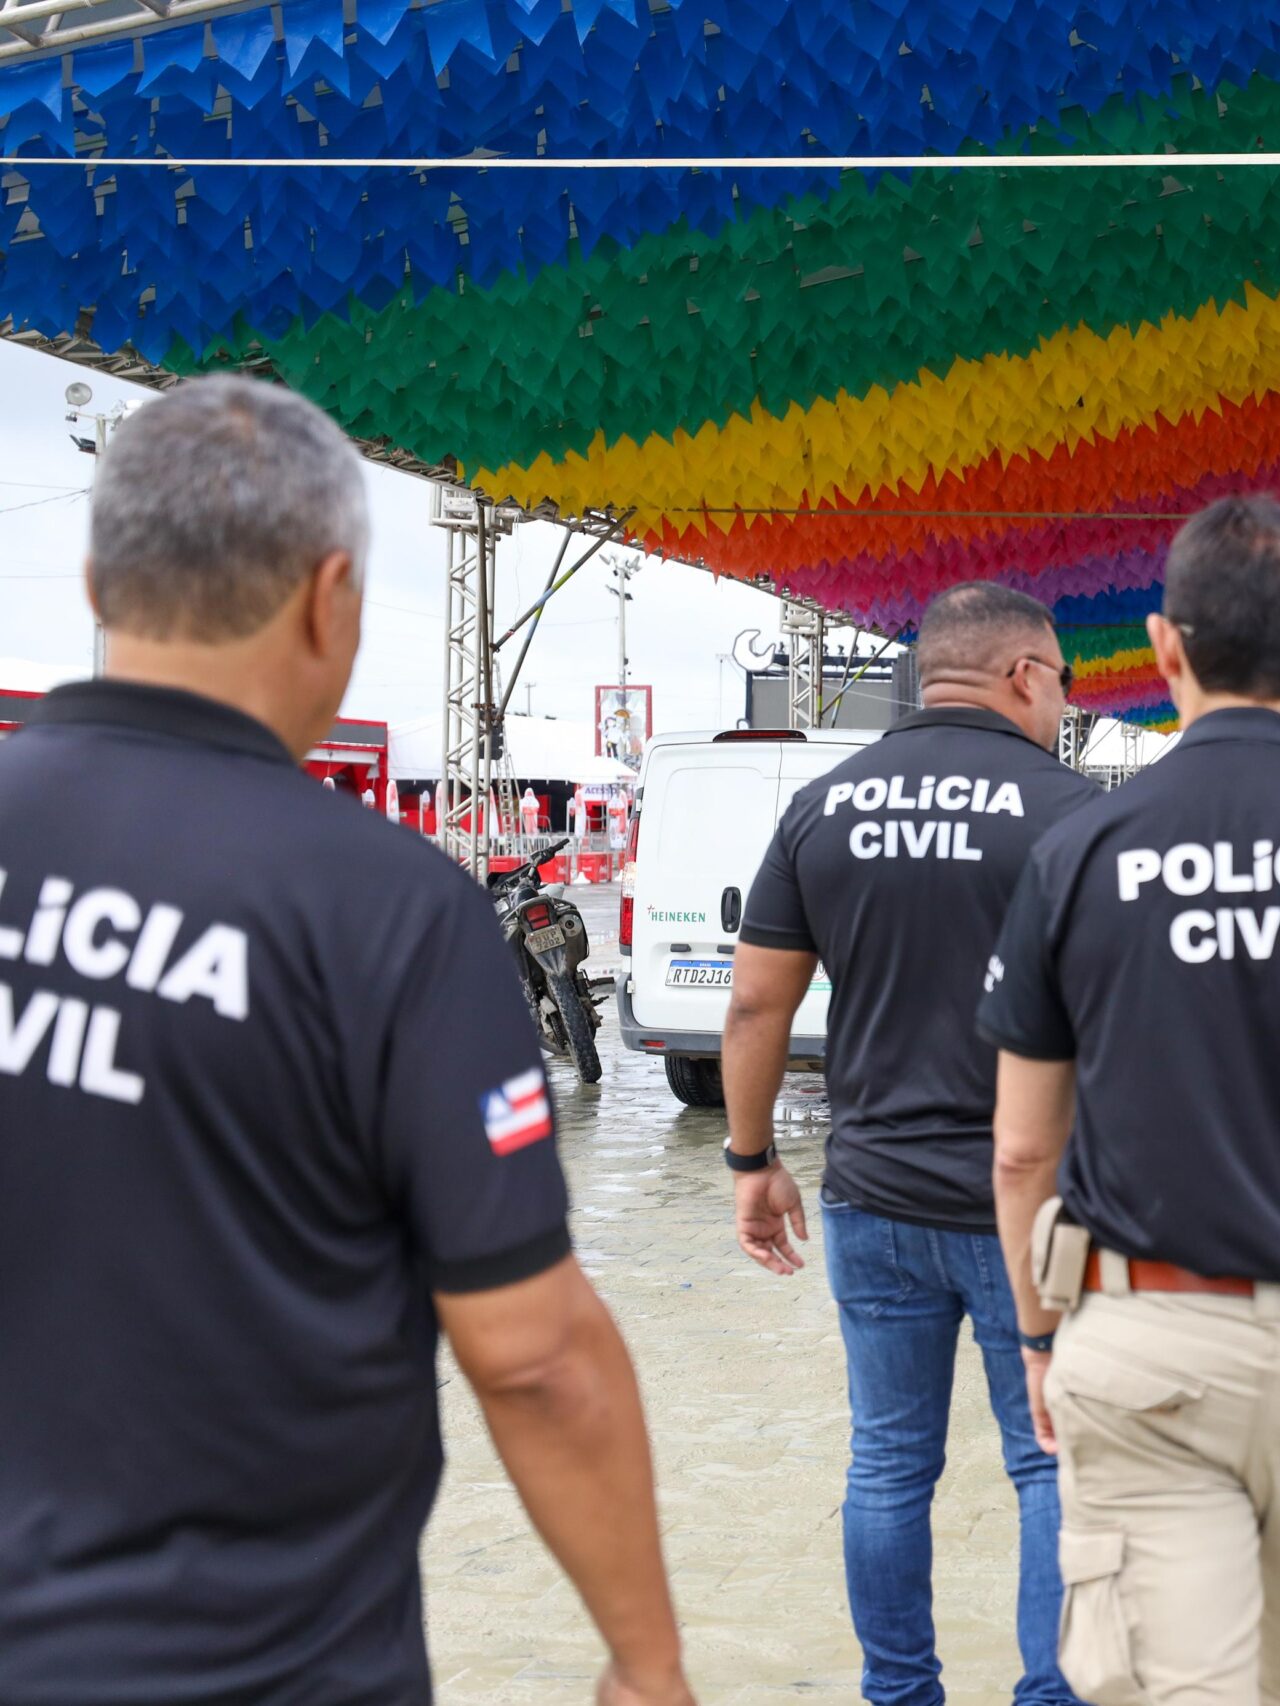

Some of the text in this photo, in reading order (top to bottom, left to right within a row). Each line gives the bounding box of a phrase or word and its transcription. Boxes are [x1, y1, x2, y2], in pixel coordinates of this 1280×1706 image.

[849, 820, 983, 861] CIVIL
[651, 911, 706, 923] HEINEKEN
[672, 968, 732, 985] RTD2J16
